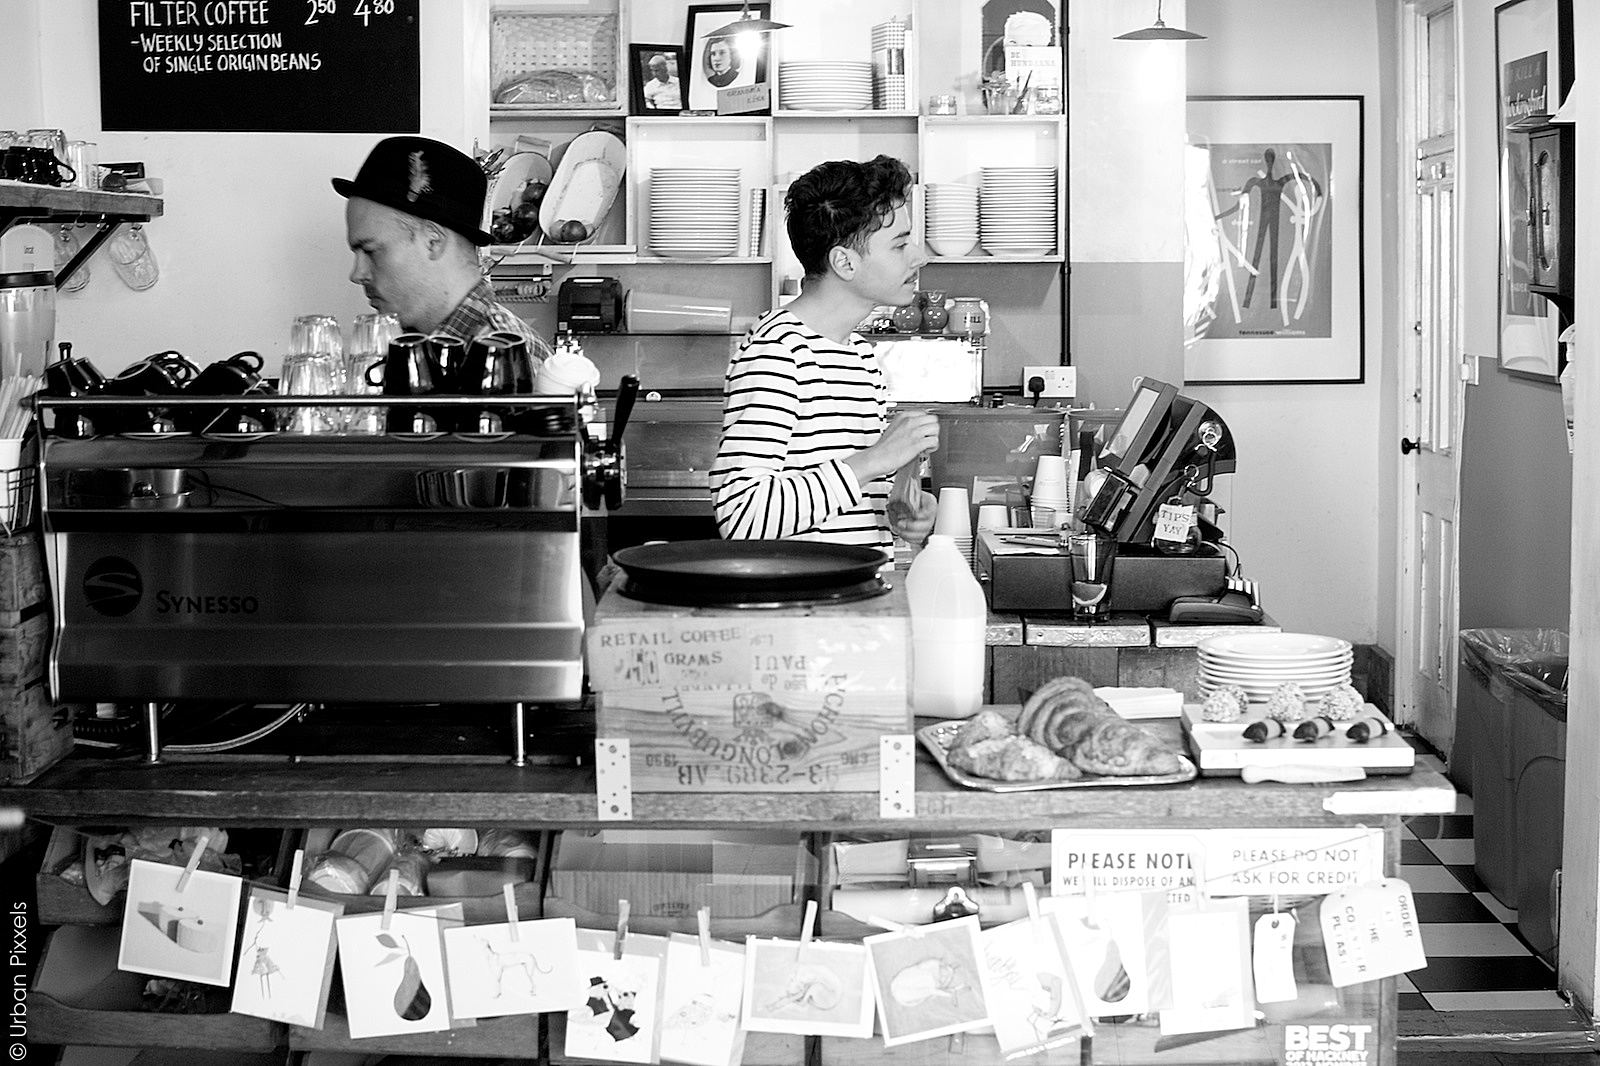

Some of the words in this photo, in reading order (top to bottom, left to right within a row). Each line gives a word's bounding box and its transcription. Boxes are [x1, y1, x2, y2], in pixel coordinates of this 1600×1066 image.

[130, 1, 200, 27] FILTER
[204, 0, 269, 26] COFFEE
[207, 32, 282, 51] SELECTION
[143, 56, 161, 73] OF
[165, 54, 213, 74] SINGLE
[217, 53, 268, 72] ORIGIN
[270, 53, 322, 71] BEANS
[1161, 510, 1190, 523] TIPS
[663, 651, 723, 666] GRAMS
[1232, 850, 1287, 862] PLEASE
[1294, 850, 1317, 862] DO
[1325, 850, 1358, 862] NOT
[1063, 876, 1078, 886] WE
[1113, 876, 1155, 887] DISPOSE
[1161, 876, 1173, 887] OF
[1179, 876, 1195, 887] AN
[1232, 871, 1262, 884] ASK
[1269, 871, 1299, 884] FOR
[1398, 895, 1413, 938] ORDER
[1284, 1024, 1372, 1051] BEST
[1285, 1051, 1305, 1061] OF
[1305, 1050, 1369, 1062] HACKNEY
